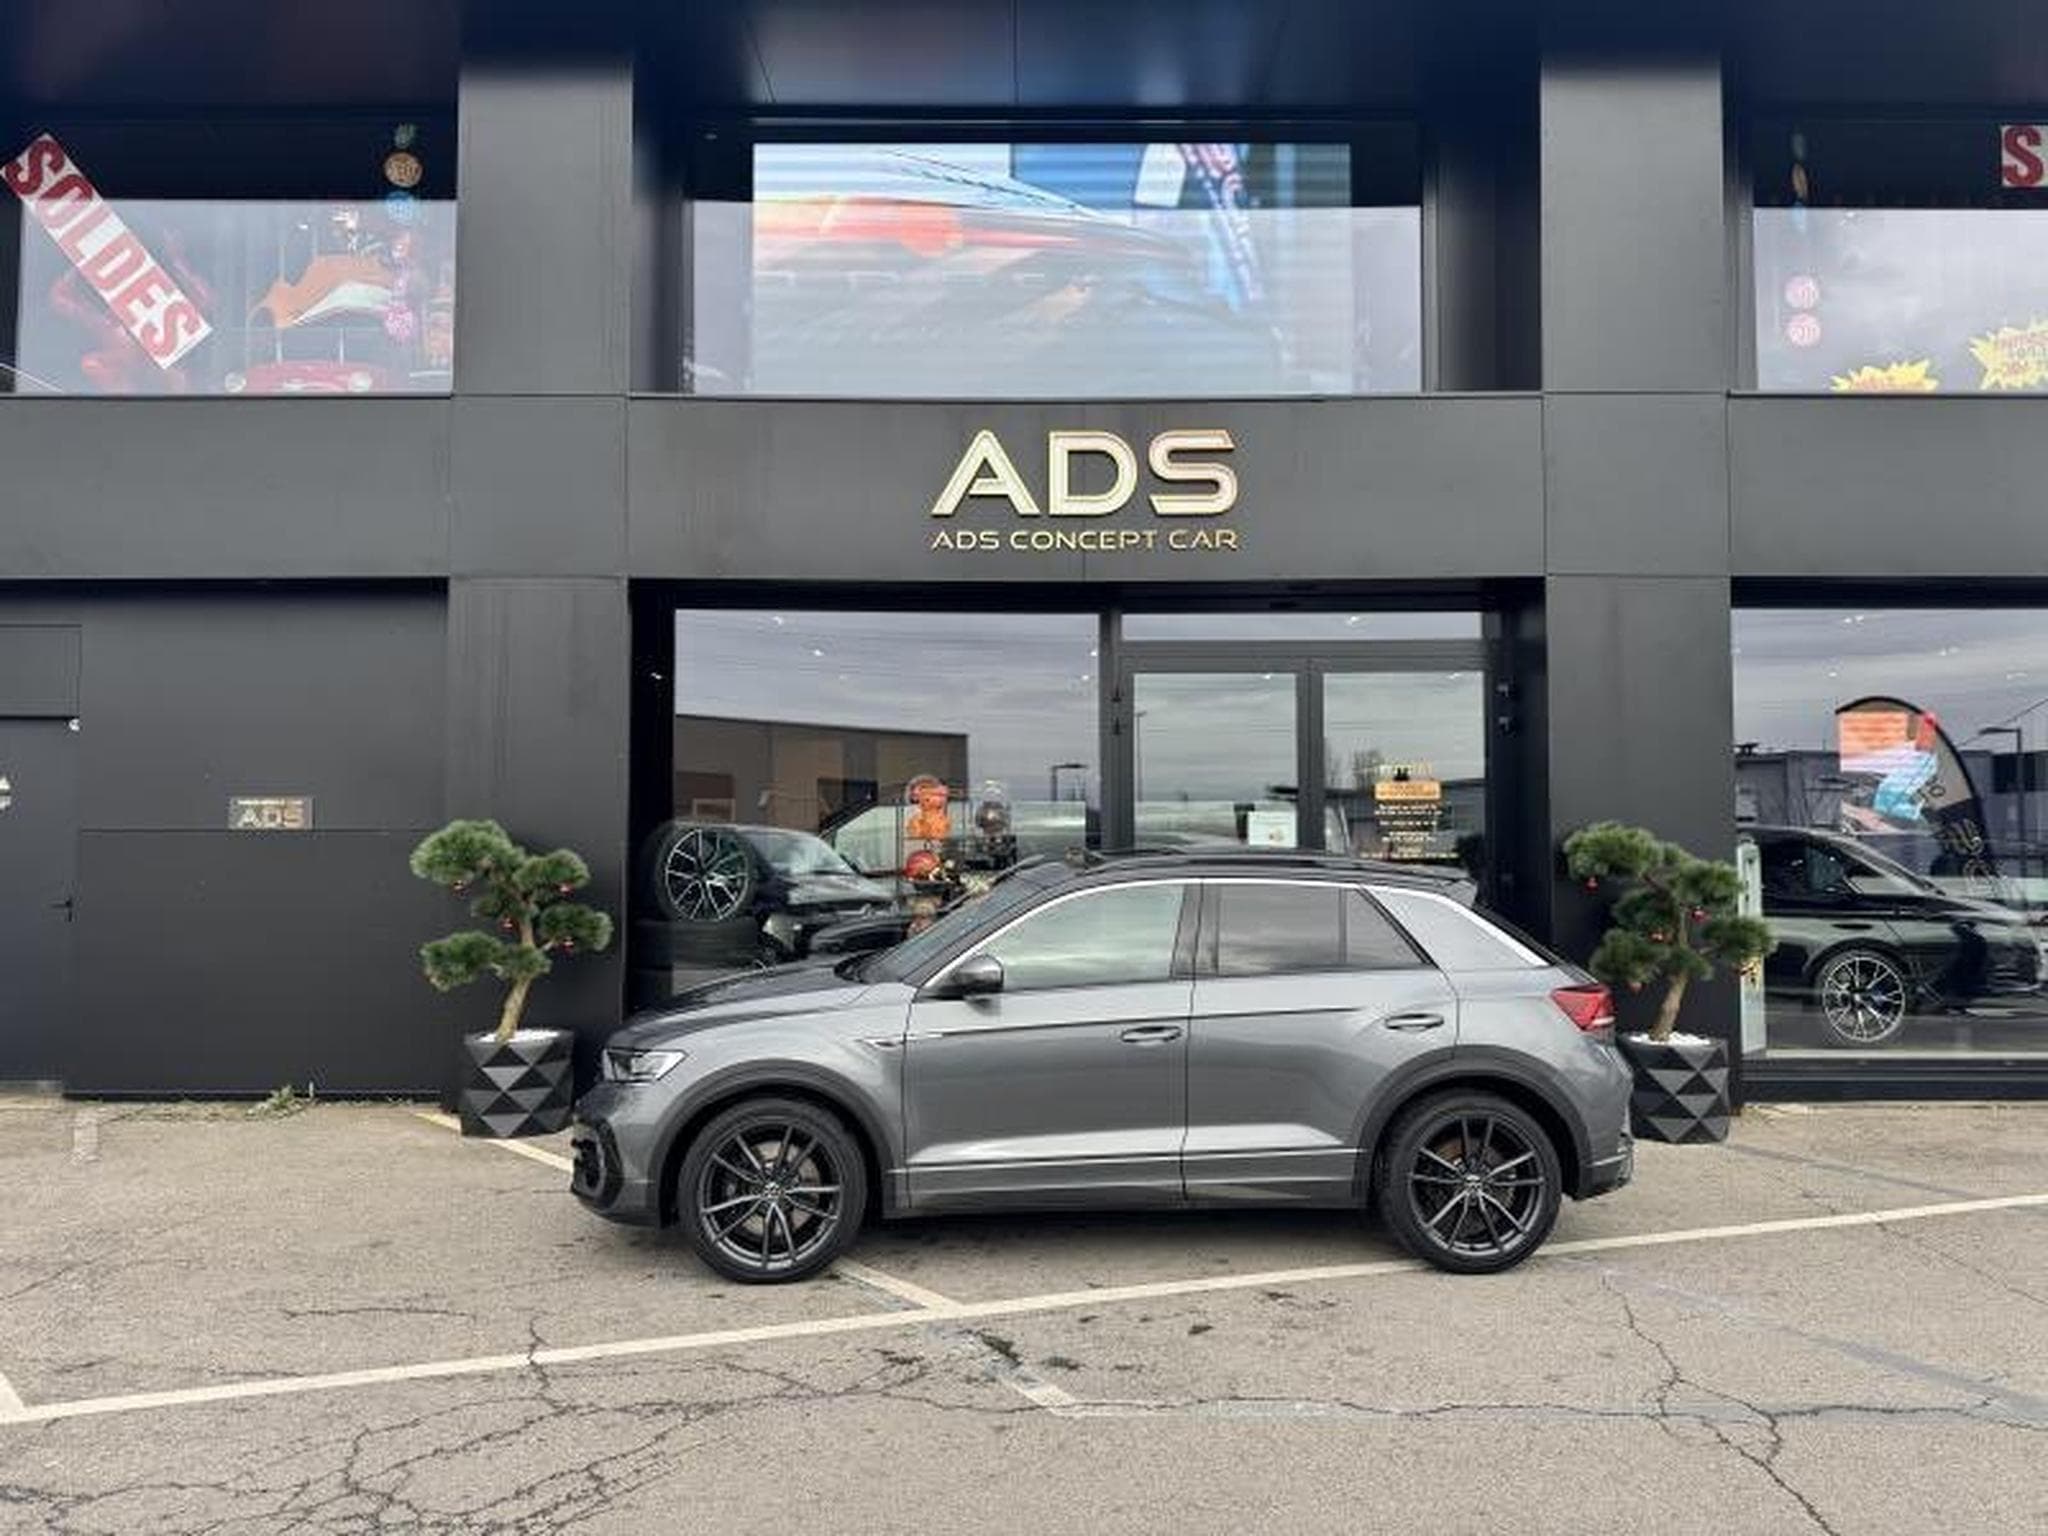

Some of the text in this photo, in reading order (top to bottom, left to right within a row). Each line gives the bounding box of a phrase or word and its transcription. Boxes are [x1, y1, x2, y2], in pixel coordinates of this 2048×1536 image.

[5, 139, 200, 358] SOLDES
[931, 429, 1239, 516] ADS
[932, 530, 1239, 550] ADS CONCEPT CAR
[237, 807, 304, 829] ADS
